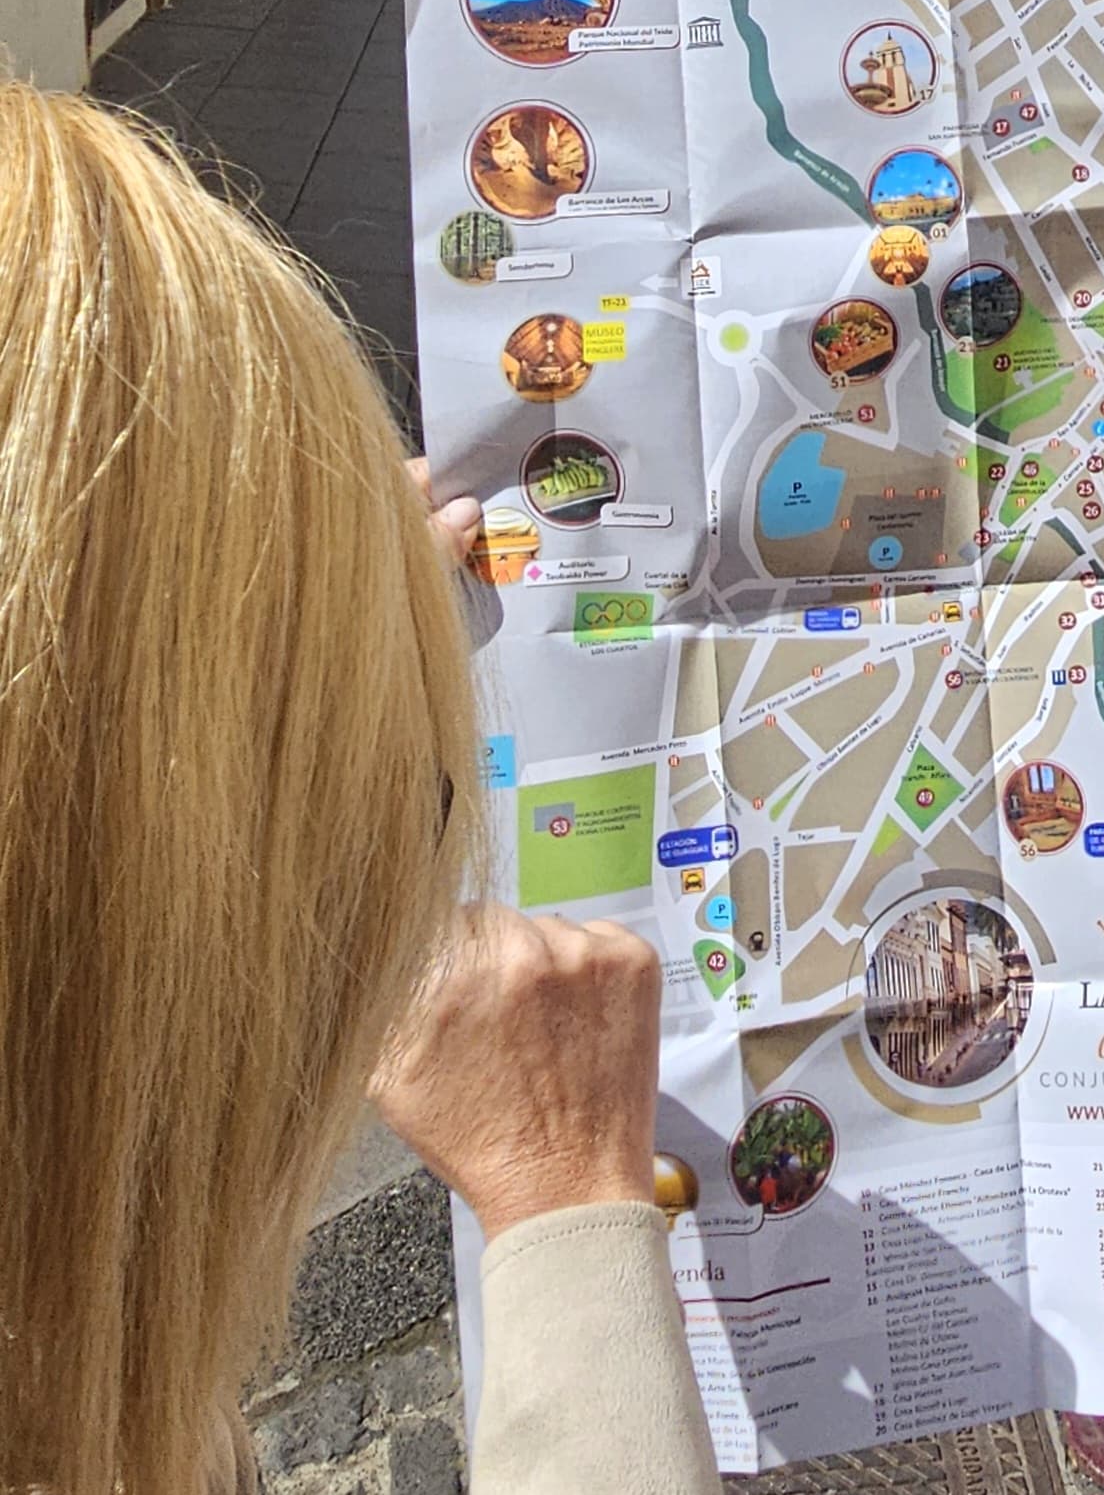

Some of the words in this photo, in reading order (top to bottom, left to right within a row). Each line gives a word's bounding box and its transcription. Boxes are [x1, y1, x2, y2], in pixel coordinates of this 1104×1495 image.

[920, 88, 934, 101] 17
[1021, 106, 1036, 118] 47
[994, 121, 1009, 133] 17
[1073, 168, 1088, 180] 18
[932, 227, 947, 238] 01
[1075, 293, 1091, 304] 20
[585, 326, 624, 338] MUSEO
[831, 375, 847, 388] 51
[859, 409, 875, 420] 51
[1088, 459, 1103, 471] 24
[990, 466, 1005, 478] 22
[793, 482, 803, 493] P
[1078, 483, 1094, 495] 25
[1084, 505, 1100, 517] 26
[976, 532, 991, 544] 23
[882, 547, 890, 556] P
[1060, 614, 1076, 627] 32
[1070, 668, 1085, 681] 33
[553, 821, 569, 834] 53
[1020, 844, 1036, 856] 56
[709, 955, 726, 967] 42
